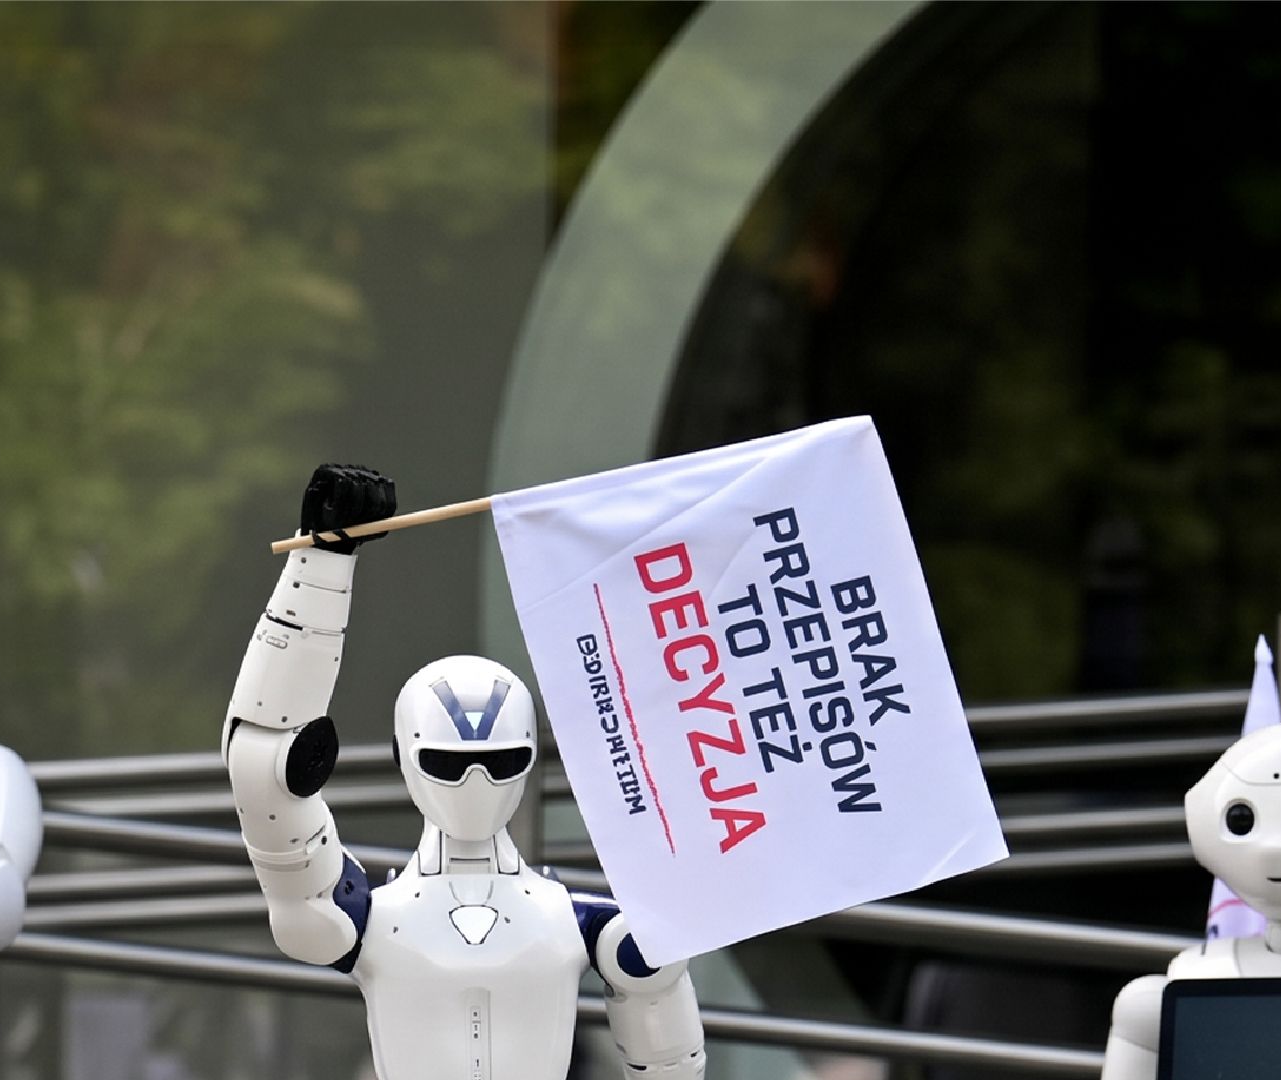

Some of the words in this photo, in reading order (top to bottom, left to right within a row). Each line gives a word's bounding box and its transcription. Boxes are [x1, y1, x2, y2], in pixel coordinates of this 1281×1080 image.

[717, 582, 772, 658] TO
[752, 507, 883, 813] PRZEPISÓW
[830, 575, 911, 727] BRAK
[634, 543, 767, 853] DECYZJA
[742, 666, 811, 774] TEŻ
